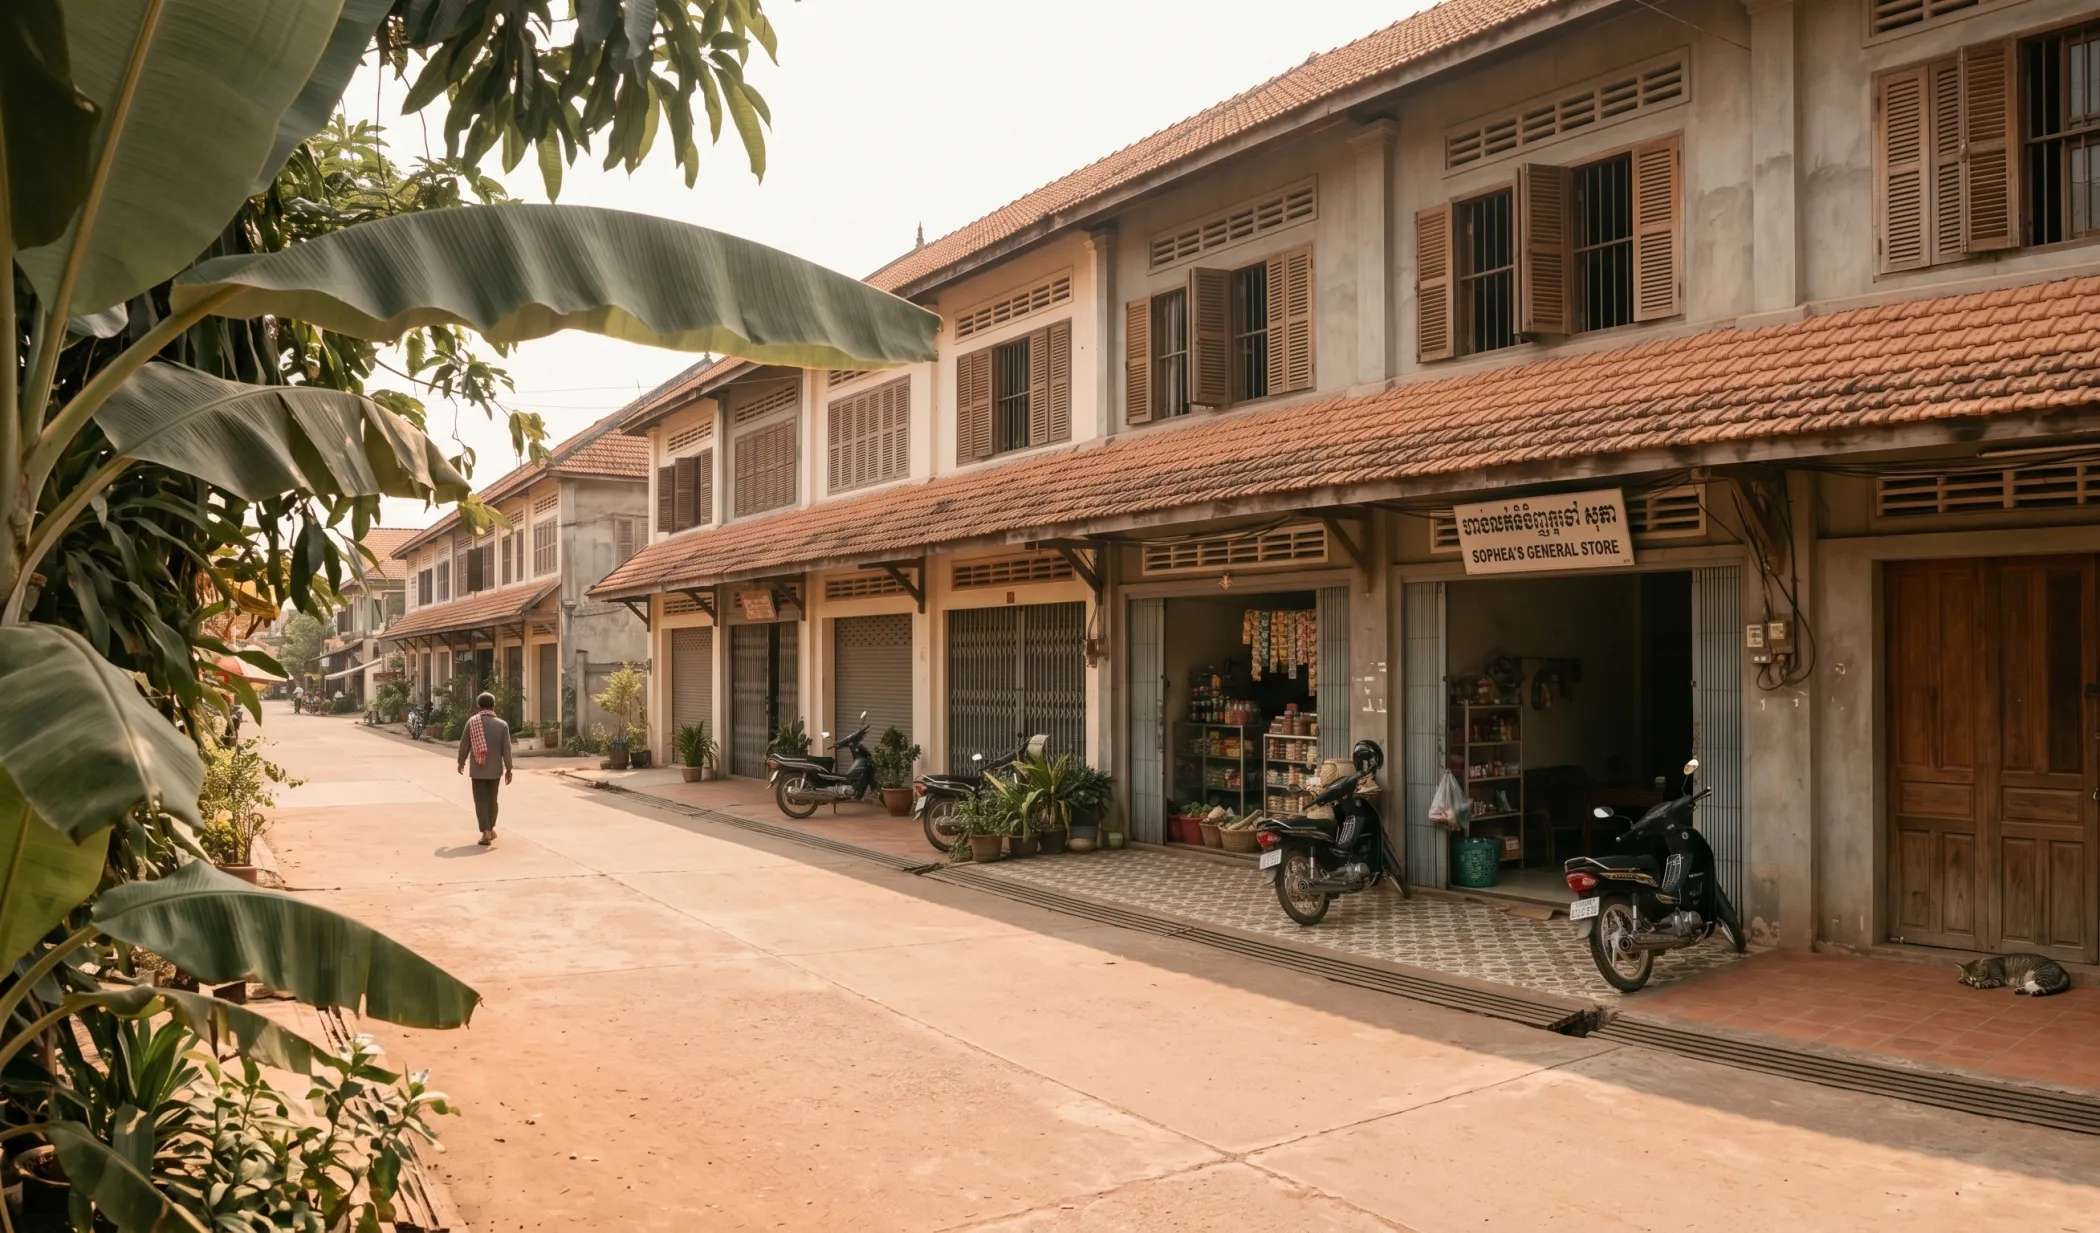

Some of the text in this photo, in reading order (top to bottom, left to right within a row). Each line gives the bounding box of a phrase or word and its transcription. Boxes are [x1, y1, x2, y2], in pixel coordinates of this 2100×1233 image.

[1472, 539, 1620, 564] SOPHEA'S GENERAL STORE
